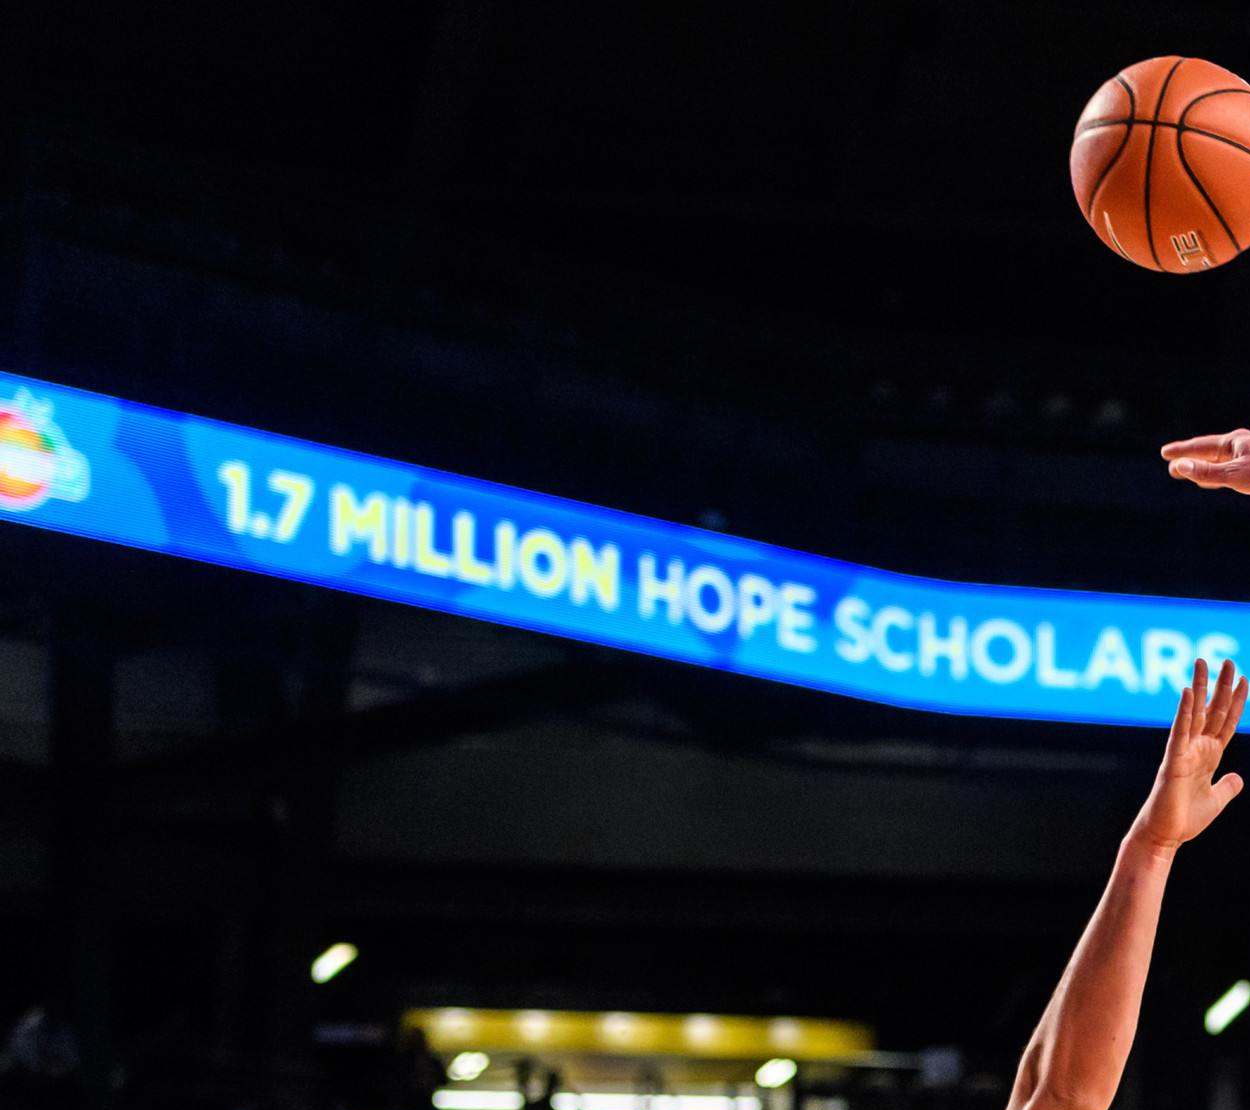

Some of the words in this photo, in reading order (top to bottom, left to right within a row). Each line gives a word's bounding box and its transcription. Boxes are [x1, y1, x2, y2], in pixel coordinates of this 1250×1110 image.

[218, 460, 313, 542] 1.7
[328, 483, 621, 612] MILLION
[638, 552, 817, 653] HOPE
